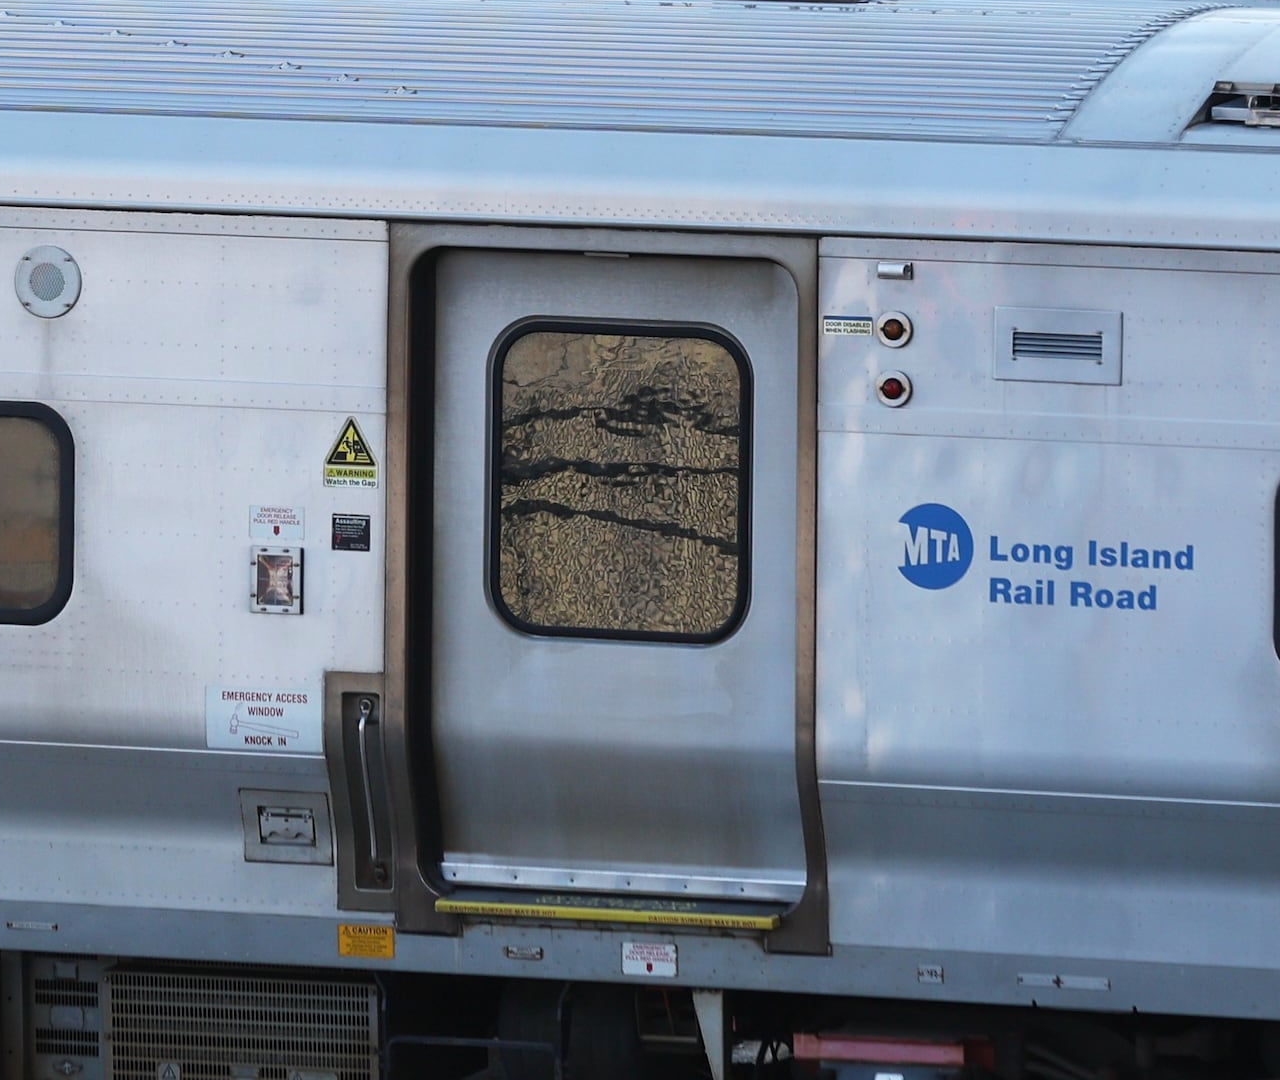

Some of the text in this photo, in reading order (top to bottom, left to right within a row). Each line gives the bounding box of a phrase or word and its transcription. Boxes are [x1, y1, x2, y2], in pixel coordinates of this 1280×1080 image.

[843, 321, 871, 329] DISABLED
[335, 469, 374, 478] WARNING
[326, 478, 348, 486] Watch
[361, 479, 376, 487] Gap
[335, 518, 366, 527] Assaulting
[989, 535, 1195, 571] Long Island
[989, 577, 1157, 611] Rail Road
[221, 690, 308, 704] EMERGENCY ACCESS
[247, 706, 284, 717] WINDOW
[244, 735, 287, 747] KNOCK IN
[352, 926, 388, 935] CAUTION
